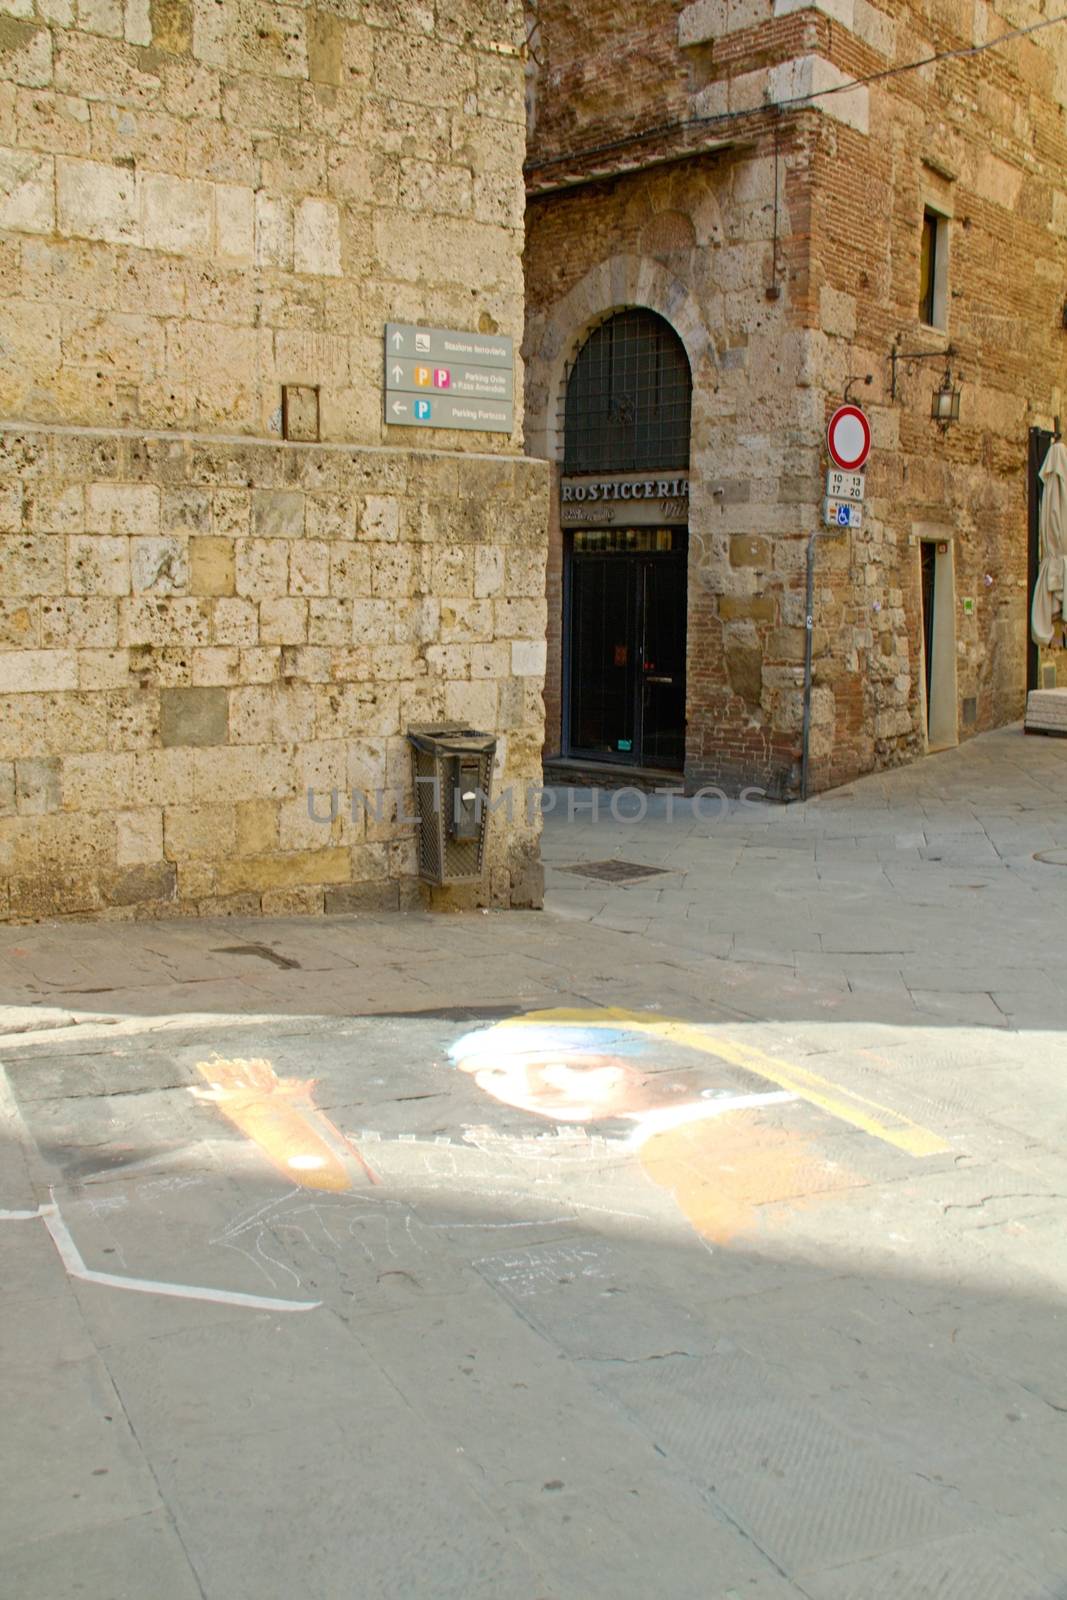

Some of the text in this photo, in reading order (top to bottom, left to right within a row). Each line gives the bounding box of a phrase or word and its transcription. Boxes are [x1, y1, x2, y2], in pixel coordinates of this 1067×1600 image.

[419, 369, 428, 385] P
[438, 369, 447, 387] P
[465, 372, 489, 384] Parking
[418, 402, 427, 418] P
[452, 408, 477, 420] Parking
[834, 474, 843, 483] 10
[853, 477, 861, 487] 13
[832, 485, 841, 494] 17
[850, 487, 861, 497] 20
